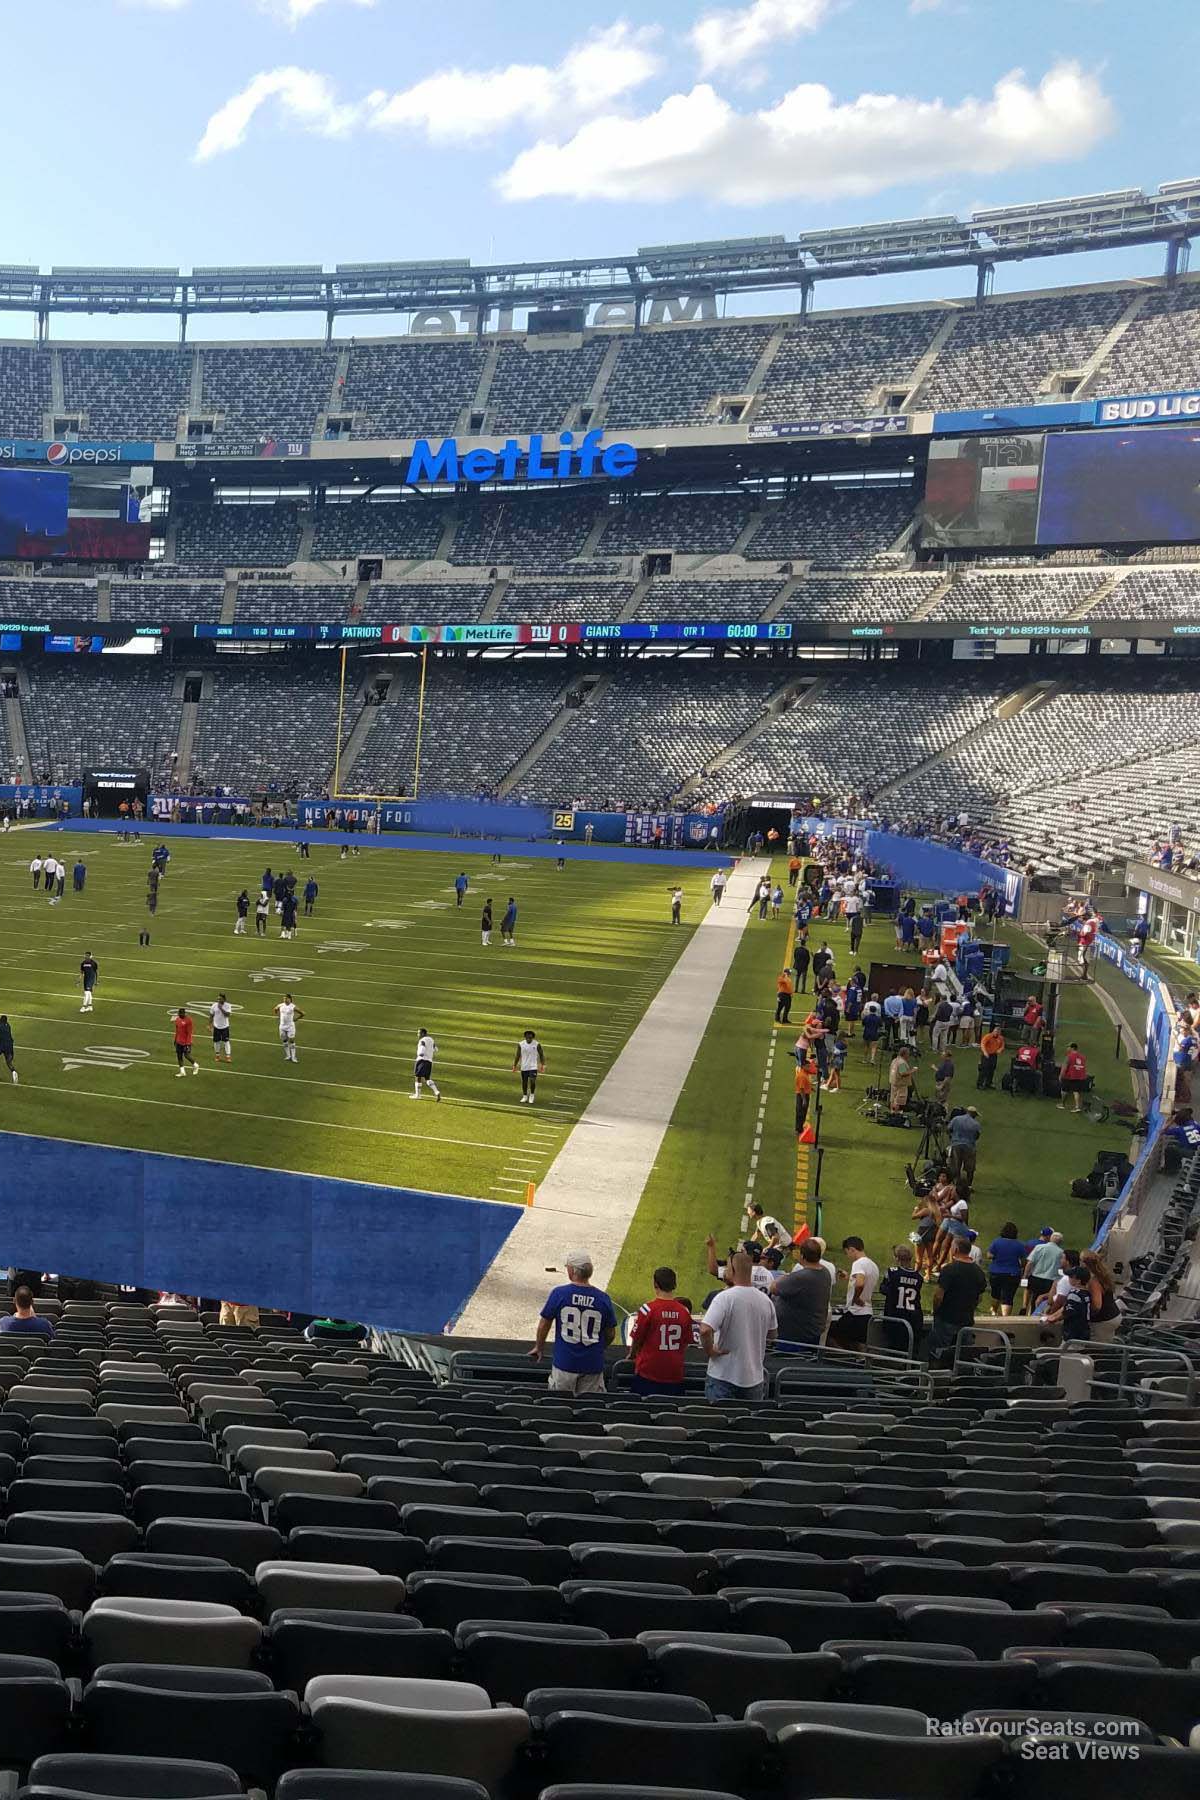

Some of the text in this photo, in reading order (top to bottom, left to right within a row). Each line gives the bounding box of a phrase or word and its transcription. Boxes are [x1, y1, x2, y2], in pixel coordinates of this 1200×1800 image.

[1102, 400, 1155, 421] BUD
[69, 445, 121, 465] pepsi
[406, 428, 638, 485] MetLife
[342, 627, 382, 638] PATRIOTS
[392, 627, 399, 641] 0
[465, 628, 513, 639] MetLife
[559, 626, 567, 641] 0
[586, 625, 621, 637] GIANTS
[683, 626, 697, 636] QTR
[727, 625, 758, 637] 60:00
[775, 626, 786, 636] 25
[969, 626, 989, 636] Text
[1011, 626, 1020, 635] to
[1021, 626, 1050, 635] 89129
[1051, 626, 1060, 635] to
[1061, 626, 1091, 635] enroll.
[555, 813, 572, 827] 25
[62, 1046, 150, 1070] 10
[572, 1294, 595, 1308] CRUZ
[896, 1286, 917, 1310] 12
[560, 1306, 602, 1347] 80
[659, 1324, 682, 1351] 12
